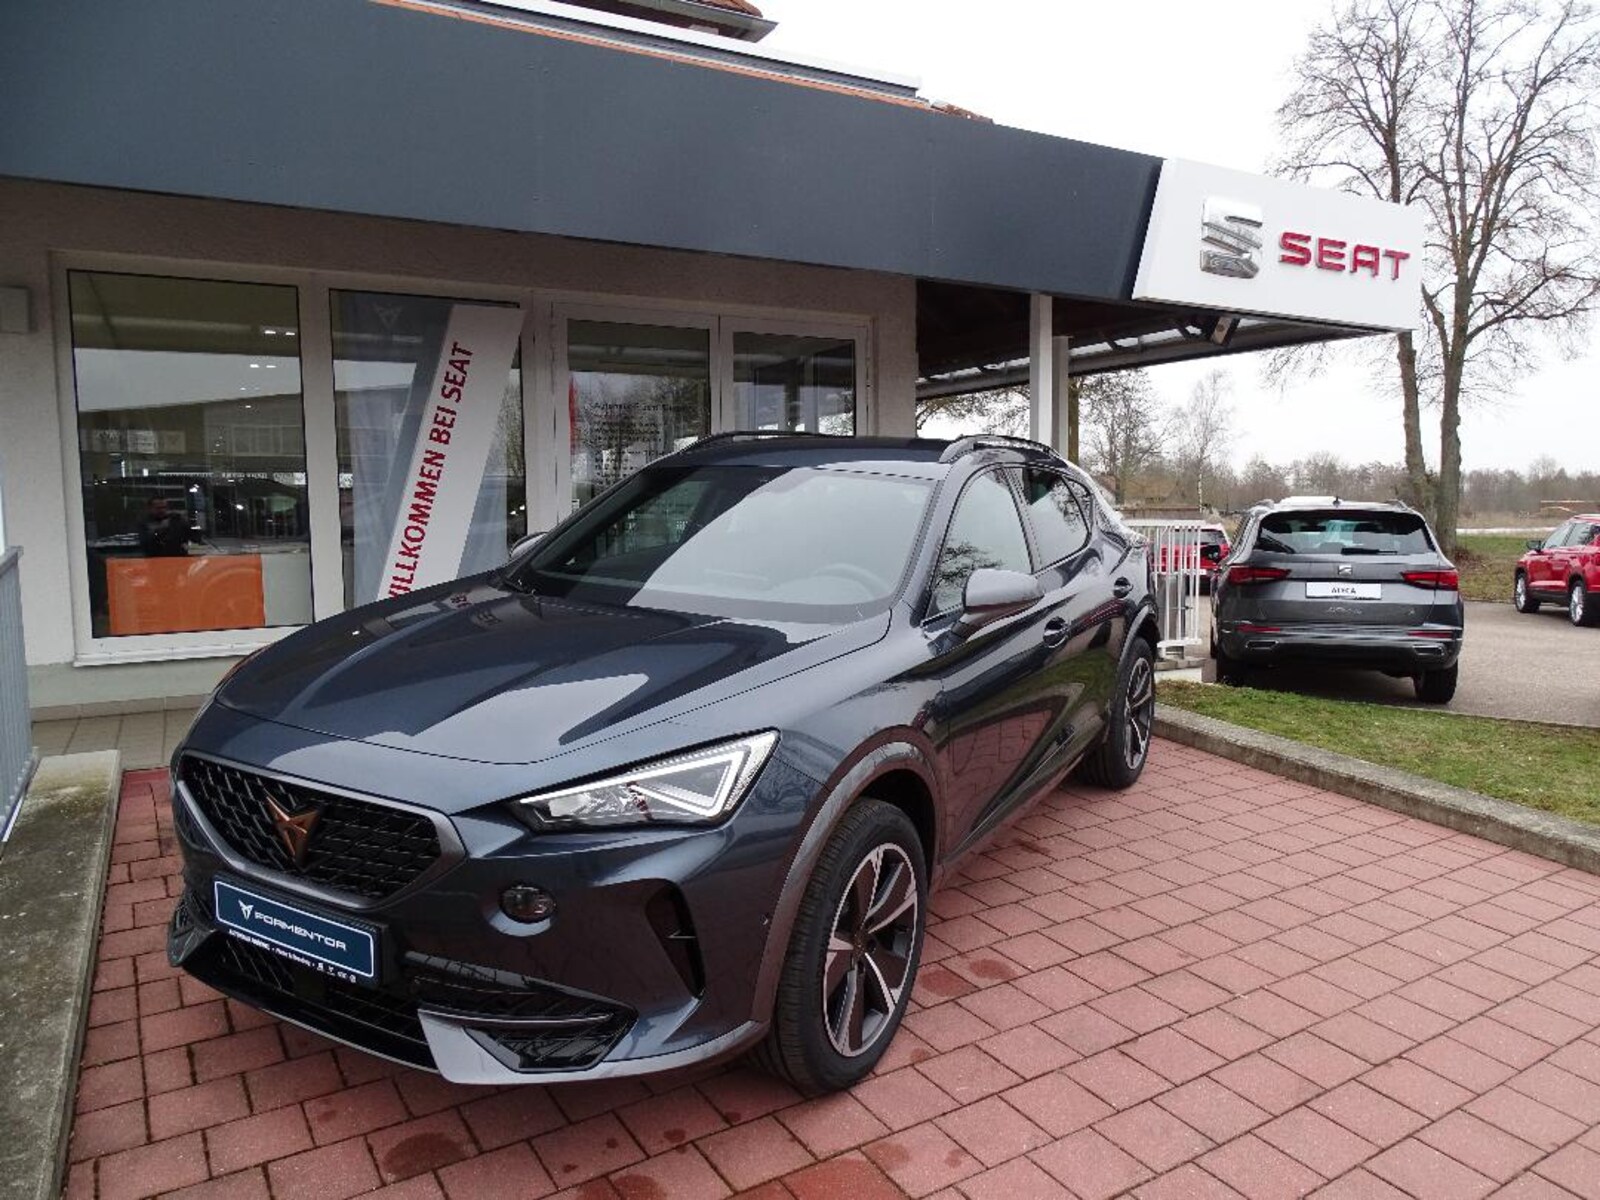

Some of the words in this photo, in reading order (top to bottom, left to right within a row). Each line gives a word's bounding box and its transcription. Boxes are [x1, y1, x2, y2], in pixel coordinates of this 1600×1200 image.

[1279, 231, 1410, 280] SEAT
[388, 450, 446, 600] ILLKOMMEN
[429, 405, 457, 445] BEI
[444, 341, 473, 403] SEAT
[254, 911, 347, 951] FORMENTOR
